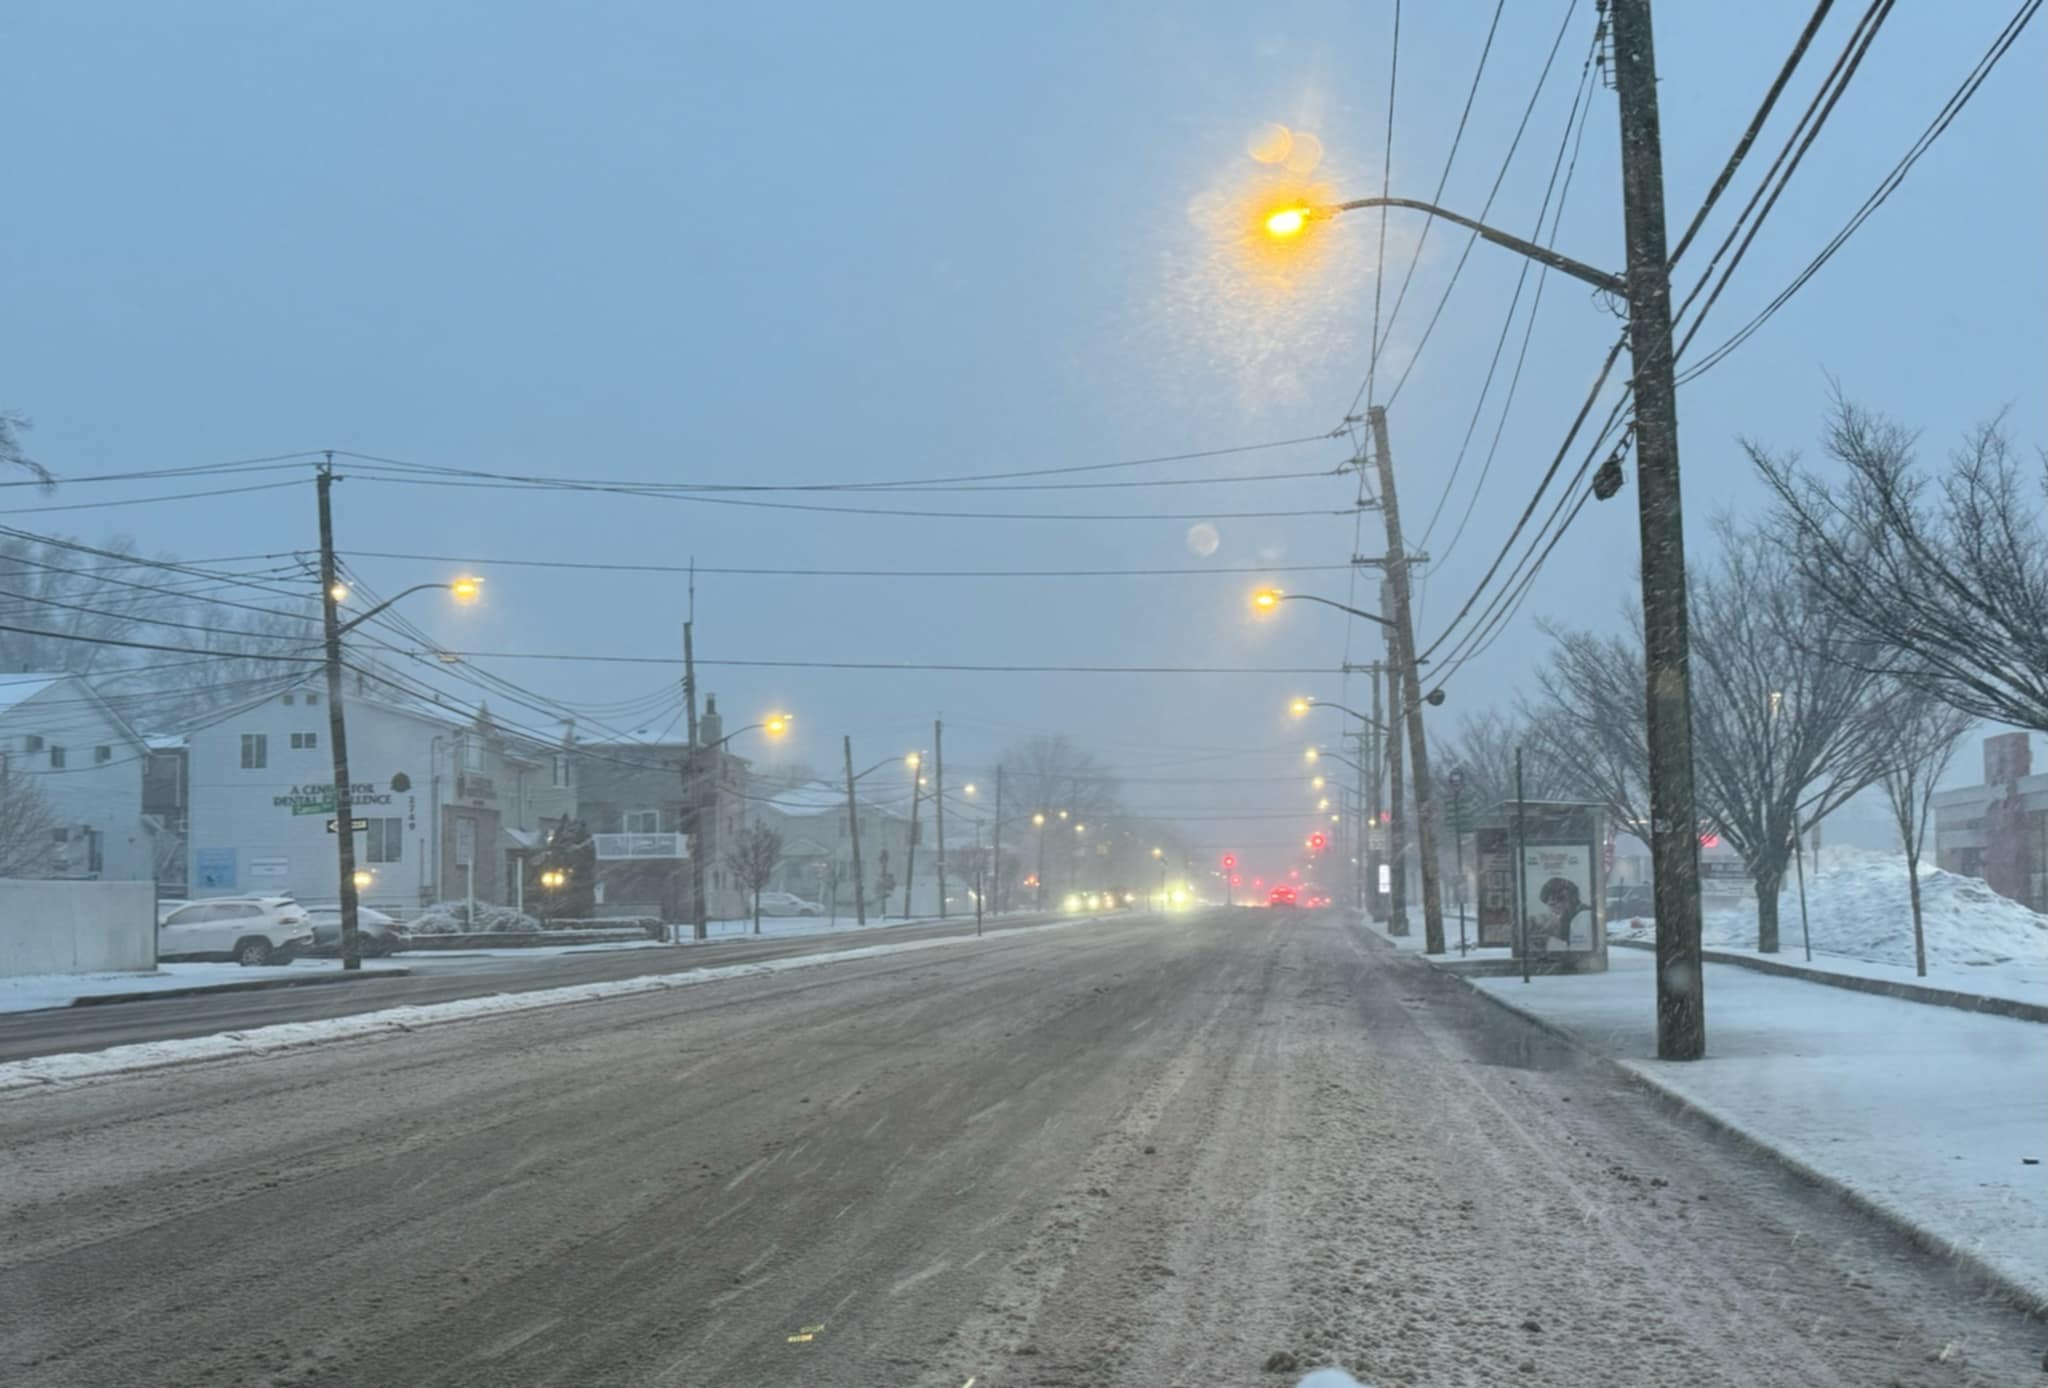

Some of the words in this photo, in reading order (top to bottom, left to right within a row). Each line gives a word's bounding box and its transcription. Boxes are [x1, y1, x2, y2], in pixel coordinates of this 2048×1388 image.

[291, 785, 300, 795] A
[351, 783, 374, 794] FOR
[273, 796, 317, 807] DENTAL
